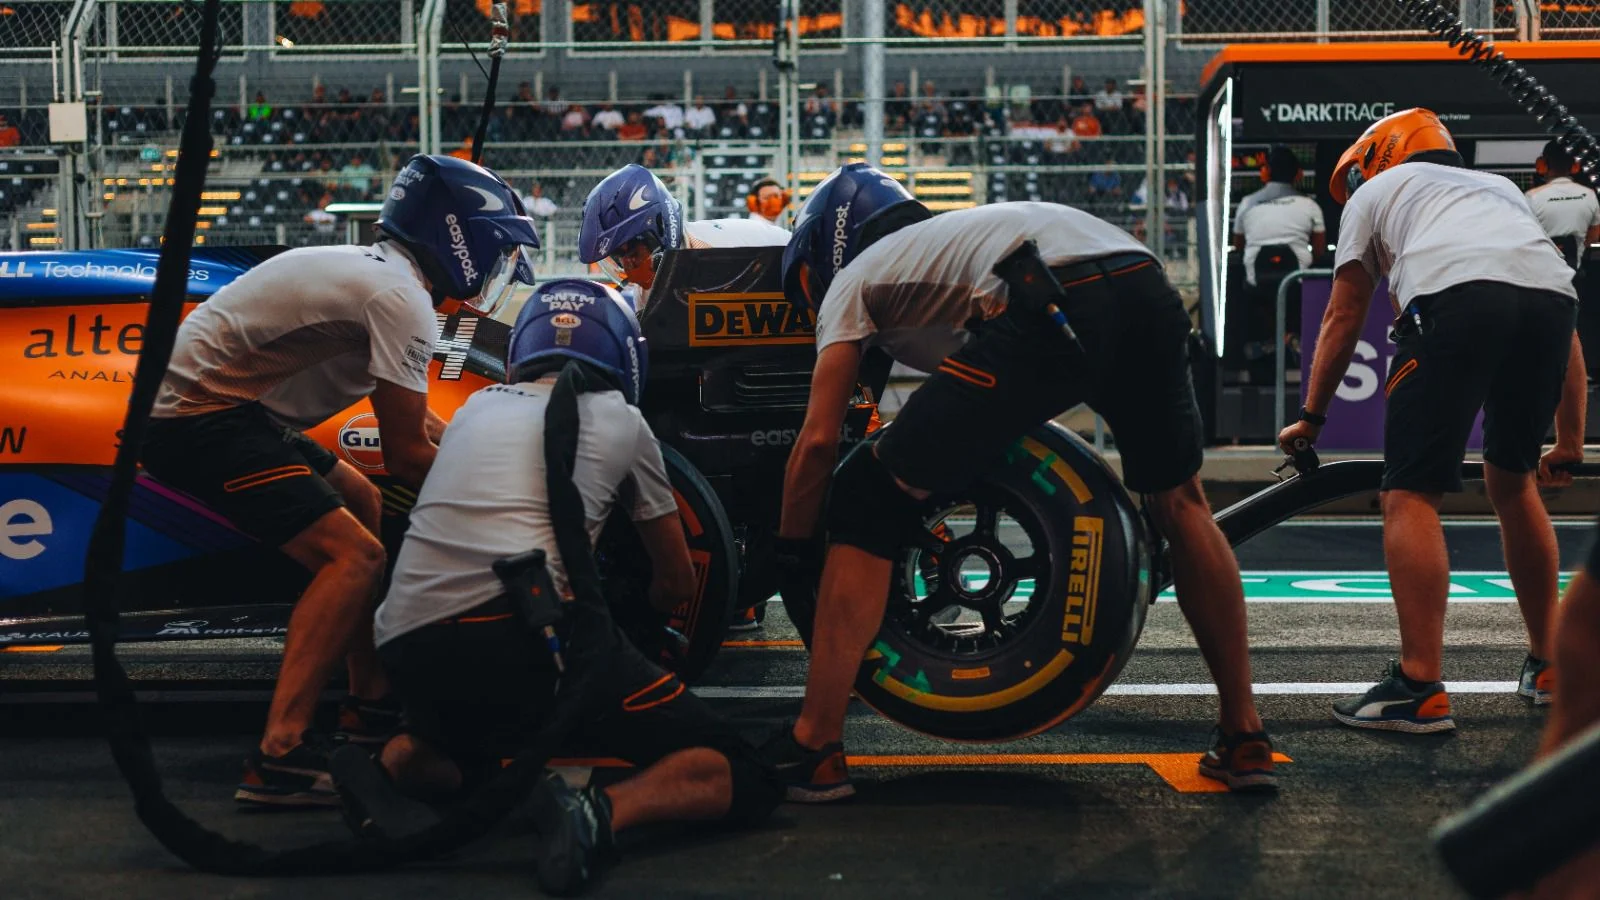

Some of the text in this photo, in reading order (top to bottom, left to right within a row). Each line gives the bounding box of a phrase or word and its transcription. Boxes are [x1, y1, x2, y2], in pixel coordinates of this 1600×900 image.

[1277, 102, 1396, 122] DARKTRACE
[445, 213, 479, 286] easypost.
[40, 261, 210, 281] Technoloes
[549, 301, 585, 311] PAY
[0, 498, 53, 560] e
[1062, 516, 1104, 646] PIRELLI
